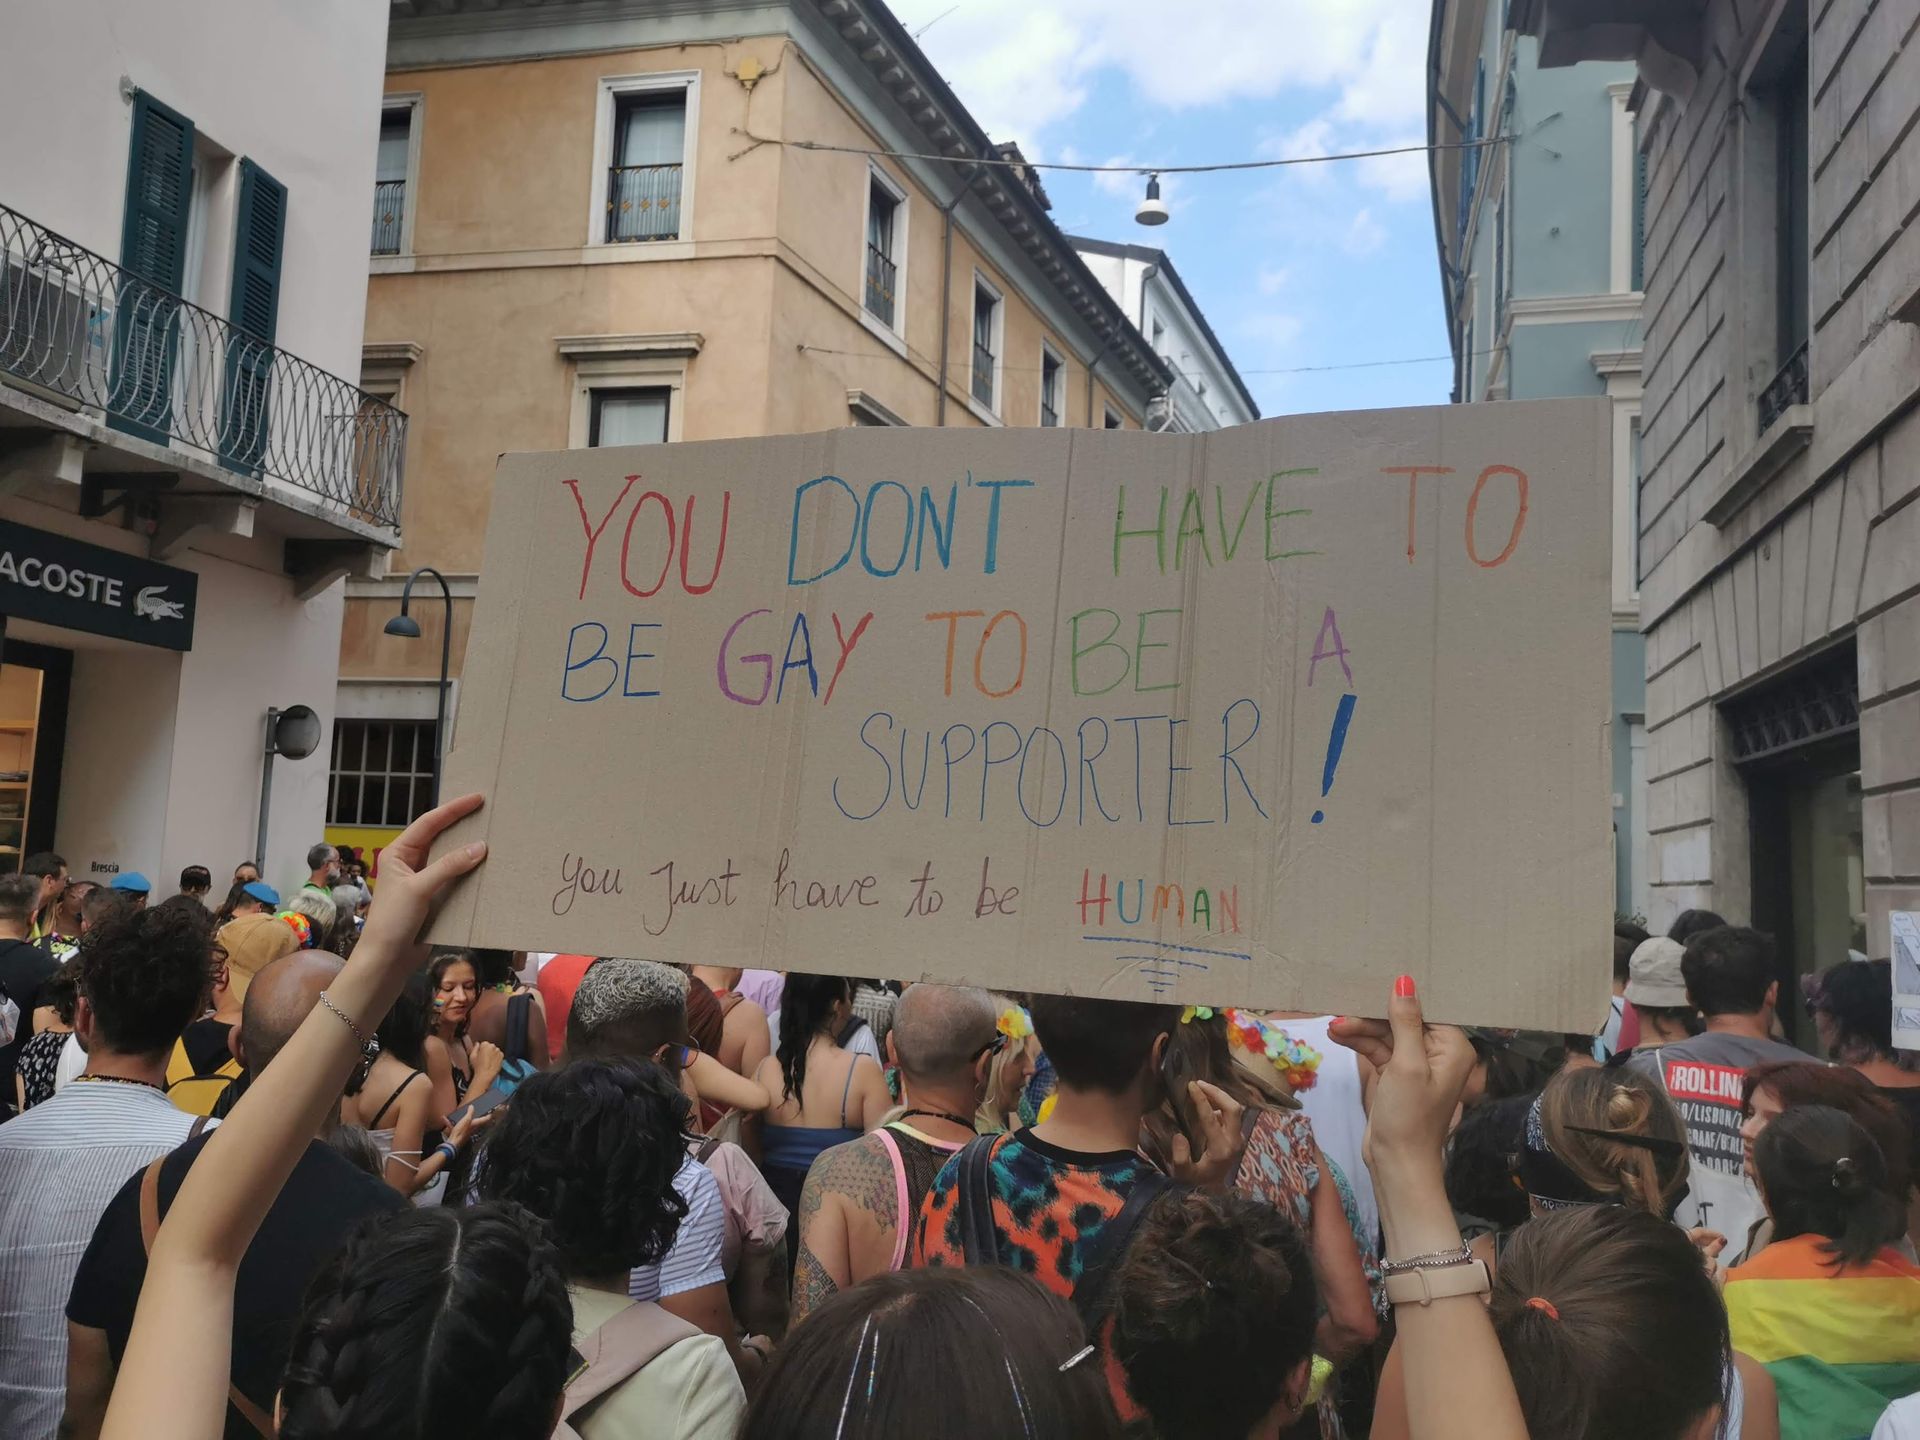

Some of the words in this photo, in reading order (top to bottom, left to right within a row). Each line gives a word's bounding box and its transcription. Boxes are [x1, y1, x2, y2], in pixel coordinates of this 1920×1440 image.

[562, 475, 730, 600] YOU
[787, 470, 1034, 585] DON'T
[1112, 467, 1325, 576] HAVE
[1380, 464, 1529, 568] TO
[0, 551, 123, 607] ACOSTE
[561, 622, 662, 702] BE
[717, 609, 874, 706] GAY
[925, 610, 1028, 698] TO
[1066, 608, 1183, 697] BE
[1307, 606, 1354, 688] A
[91, 861, 119, 873] Brescia
[774, 848, 880, 910] have
[904, 860, 944, 918] to
[974, 857, 1020, 919] be
[1075, 867, 1241, 934] HUMAN
[1674, 1065, 1743, 1100] ROLLIN
